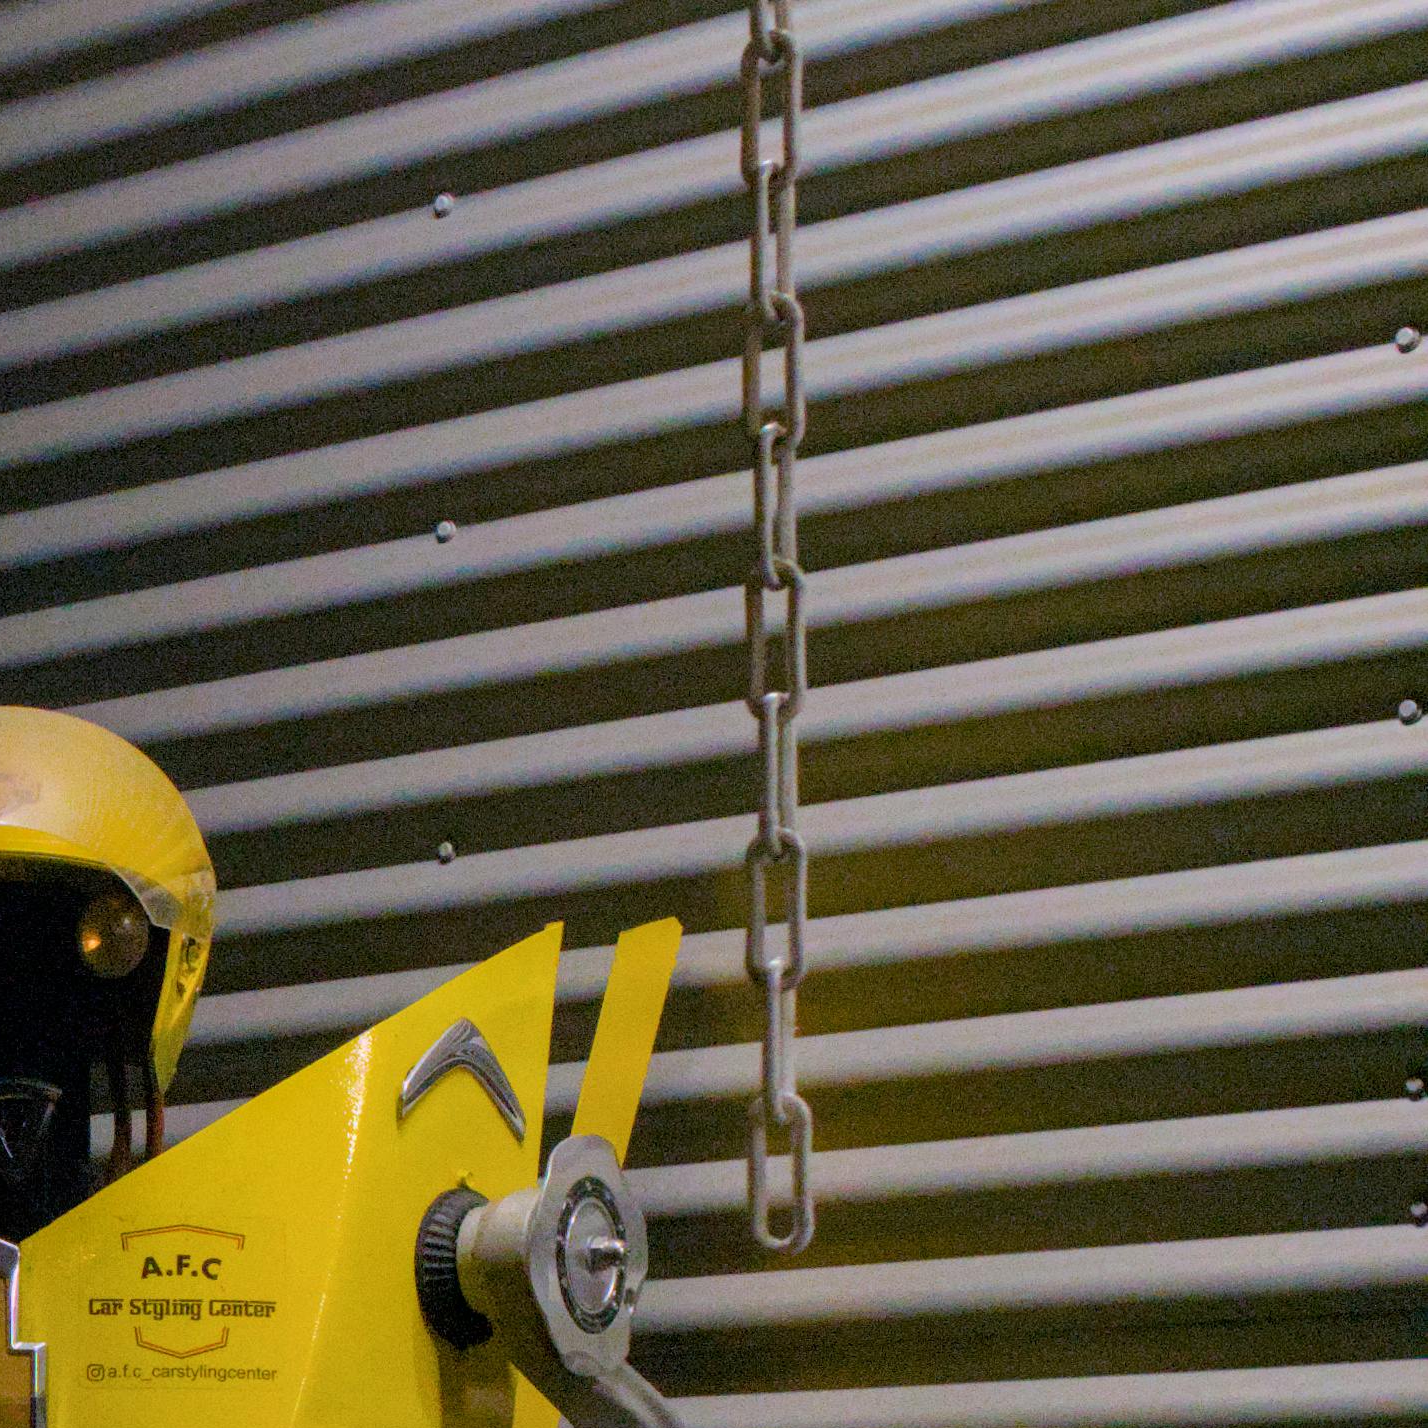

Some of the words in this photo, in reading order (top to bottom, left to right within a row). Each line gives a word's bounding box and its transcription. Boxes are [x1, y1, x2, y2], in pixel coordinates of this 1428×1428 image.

[141, 1253, 222, 1280] A.F.C
[88, 1298, 124, 1316] Car
[129, 1298, 203, 1321] Styling
[208, 1299, 277, 1318] Center
[107, 1363, 278, 1383] a.f.c_carstylingcenter
